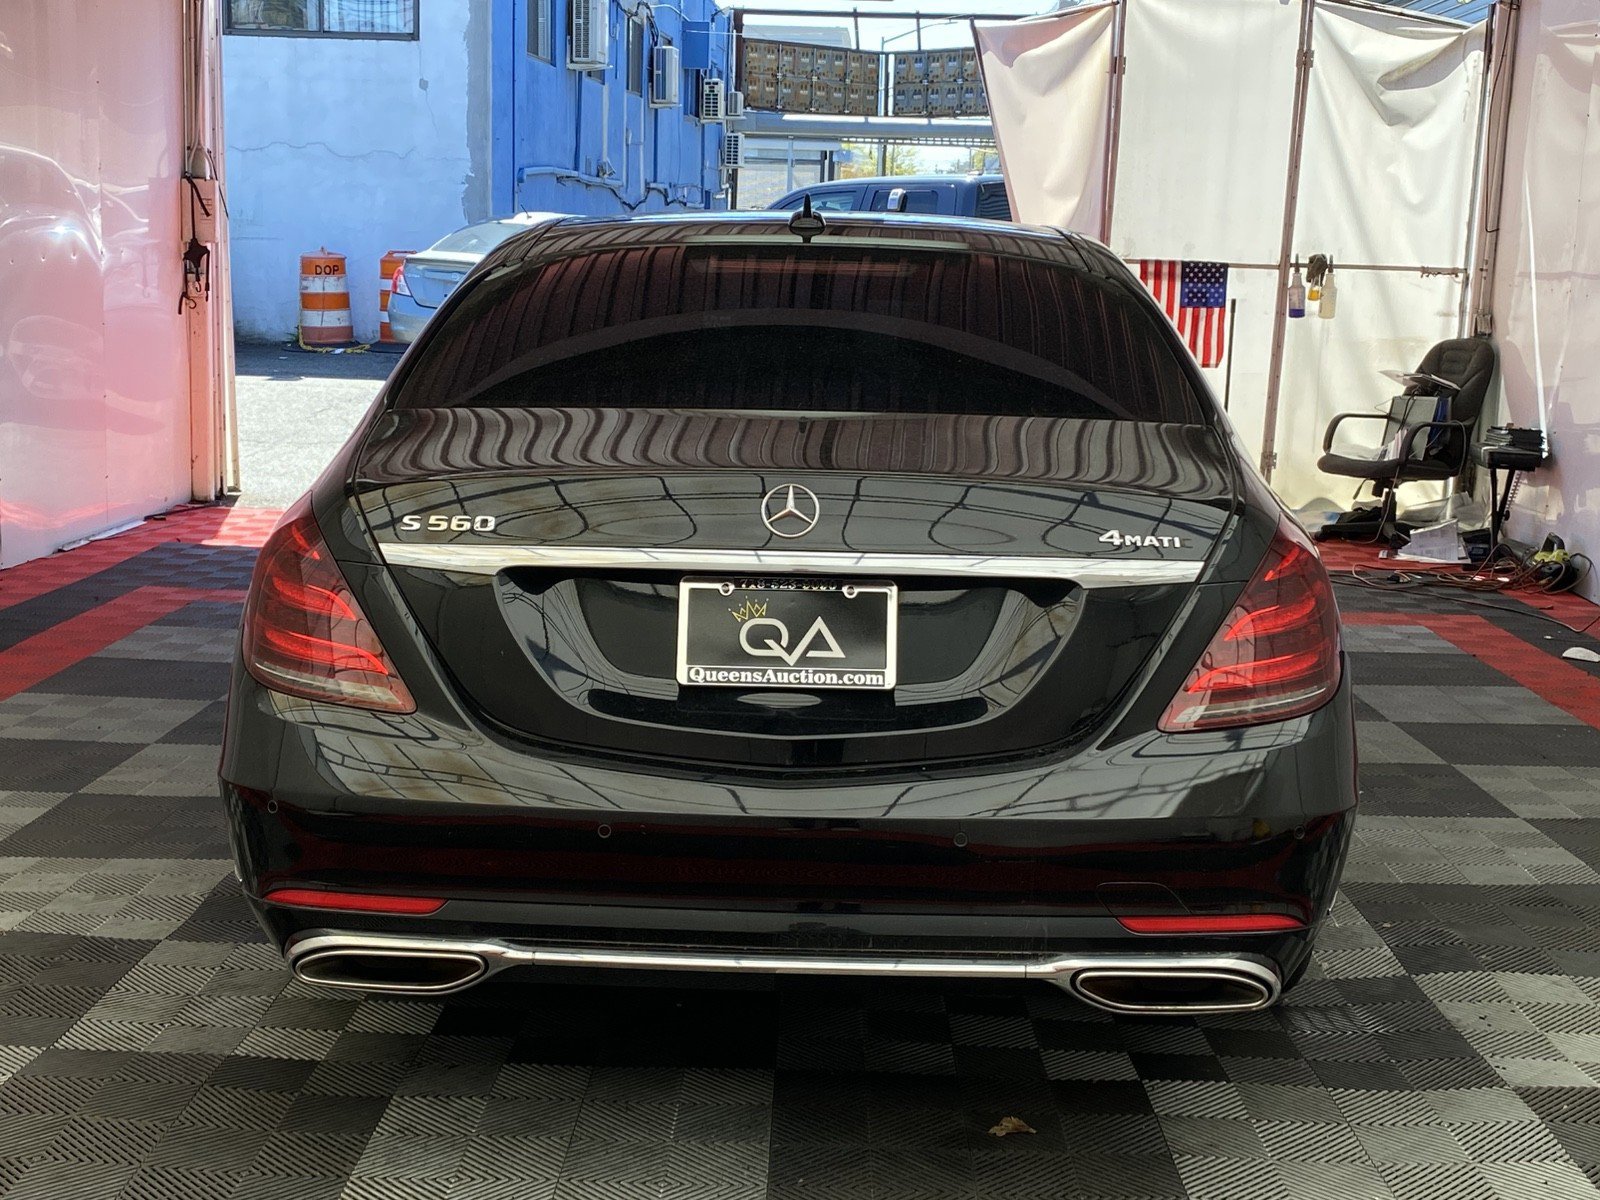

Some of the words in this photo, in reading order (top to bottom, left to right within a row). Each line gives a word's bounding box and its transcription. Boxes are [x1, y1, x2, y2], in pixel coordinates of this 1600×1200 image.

[314, 264, 340, 276] DOP
[400, 515, 422, 531] S
[427, 515, 496, 532] 560
[688, 667, 885, 686] QueensAuction.com
